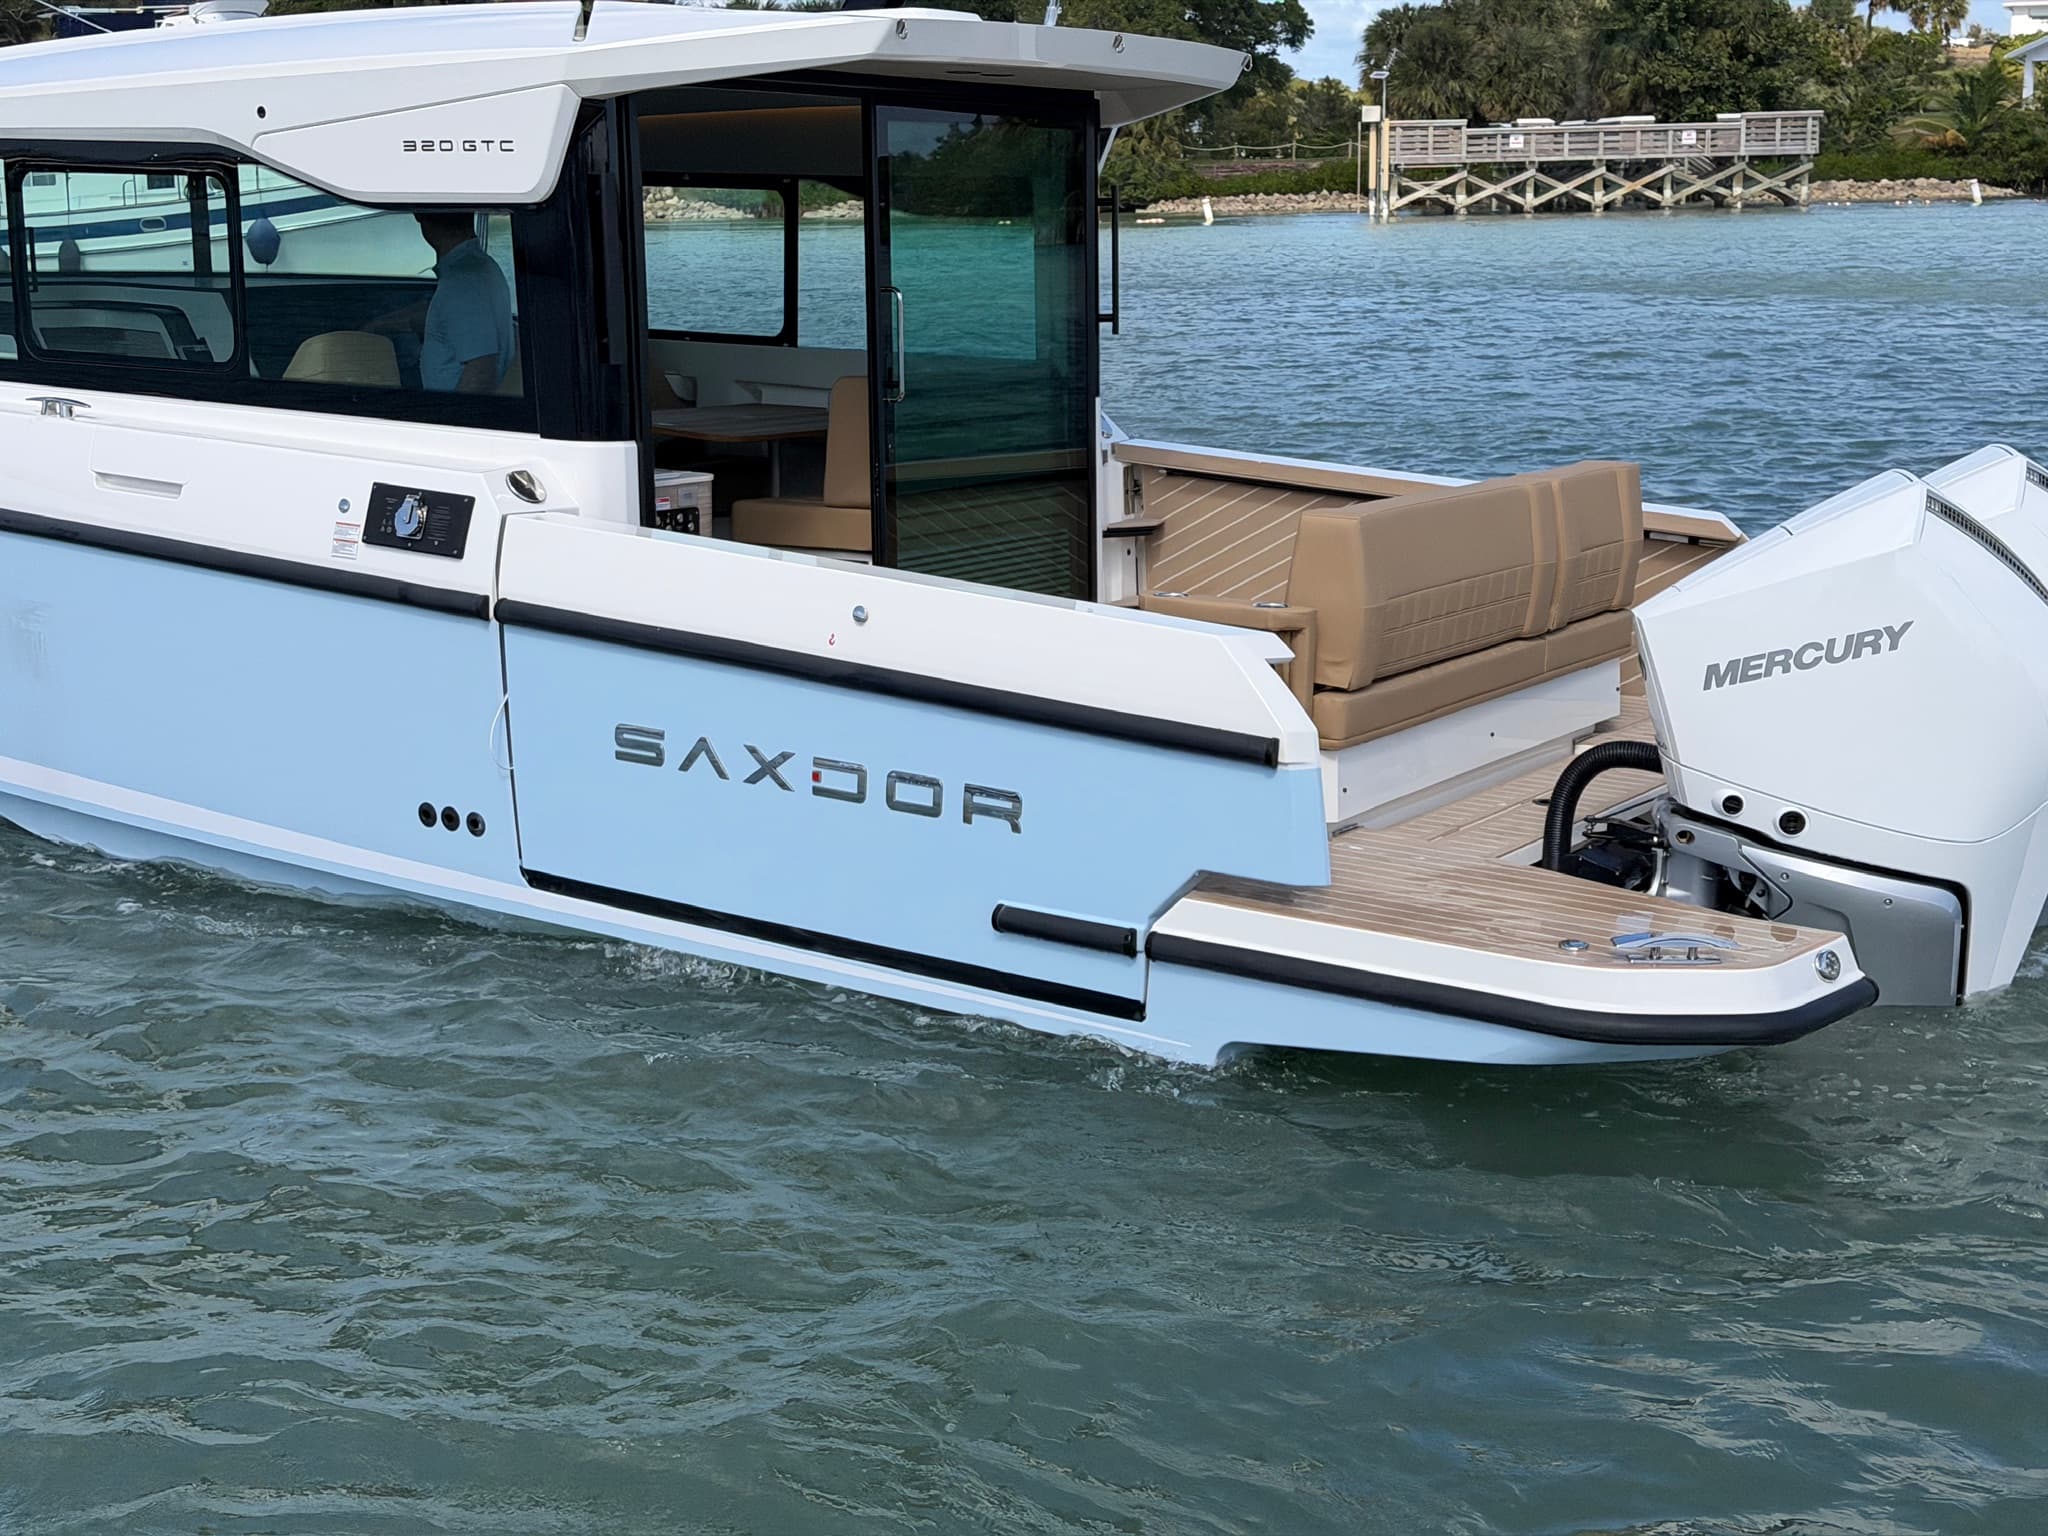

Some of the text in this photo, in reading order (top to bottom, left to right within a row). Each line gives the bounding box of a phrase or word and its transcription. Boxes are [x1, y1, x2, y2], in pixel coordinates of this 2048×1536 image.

[402, 140, 514, 152] 320 GTC
[1703, 620, 1914, 691] MERCURY
[614, 723, 1023, 834] SAXDOR
